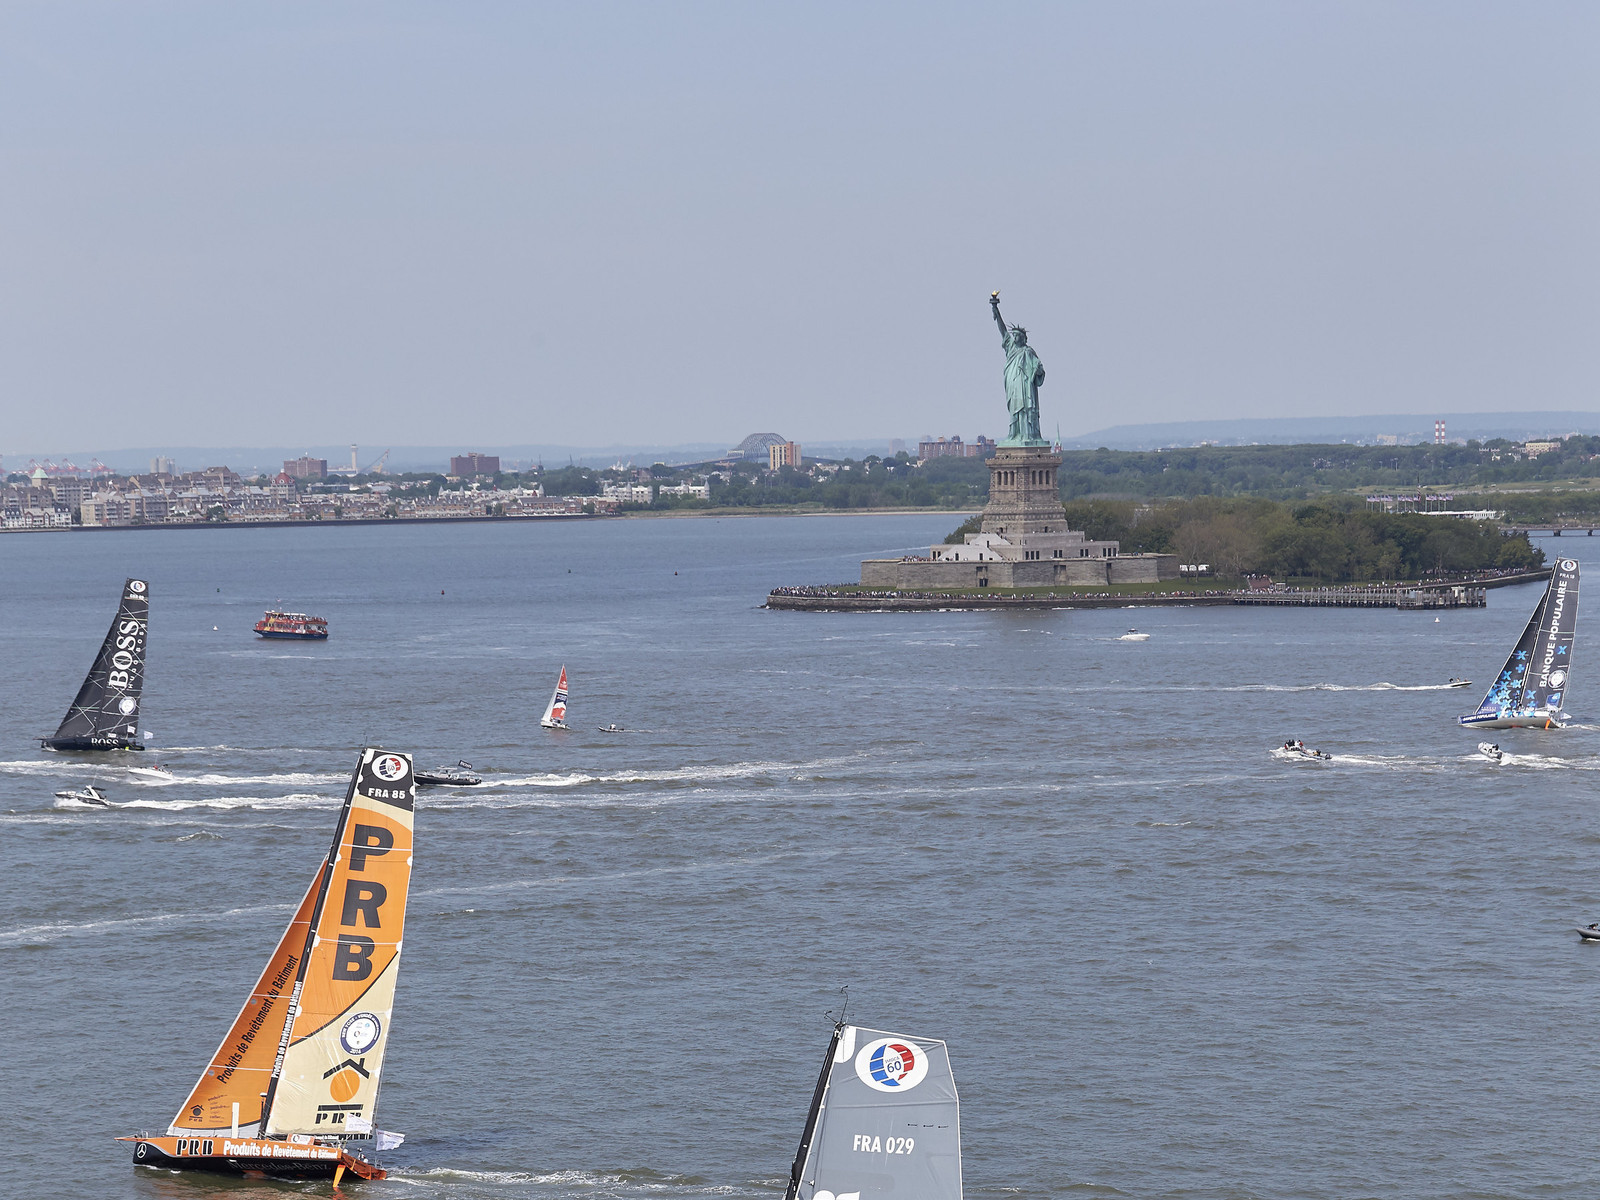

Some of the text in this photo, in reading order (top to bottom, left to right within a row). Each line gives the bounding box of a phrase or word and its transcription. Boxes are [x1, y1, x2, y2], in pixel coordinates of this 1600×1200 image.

[1539, 580, 1568, 688] BANQUE POPULAIRE
[109, 621, 139, 691] BOSS
[368, 787, 406, 799] FRA 85
[272, 954, 299, 990] Bâtiment
[267, 990, 279, 999] du
[241, 998, 274, 1043] Revêtement
[236, 1043, 249, 1054] de
[217, 1053, 242, 1084] Produits
[887, 1061, 902, 1073] 60
[176, 1139, 214, 1156] PRB
[223, 1140, 261, 1157] Produits
[261, 1144, 272, 1157] de
[272, 1145, 310, 1158] Revêtement
[853, 1134, 915, 1155] FRA 029
